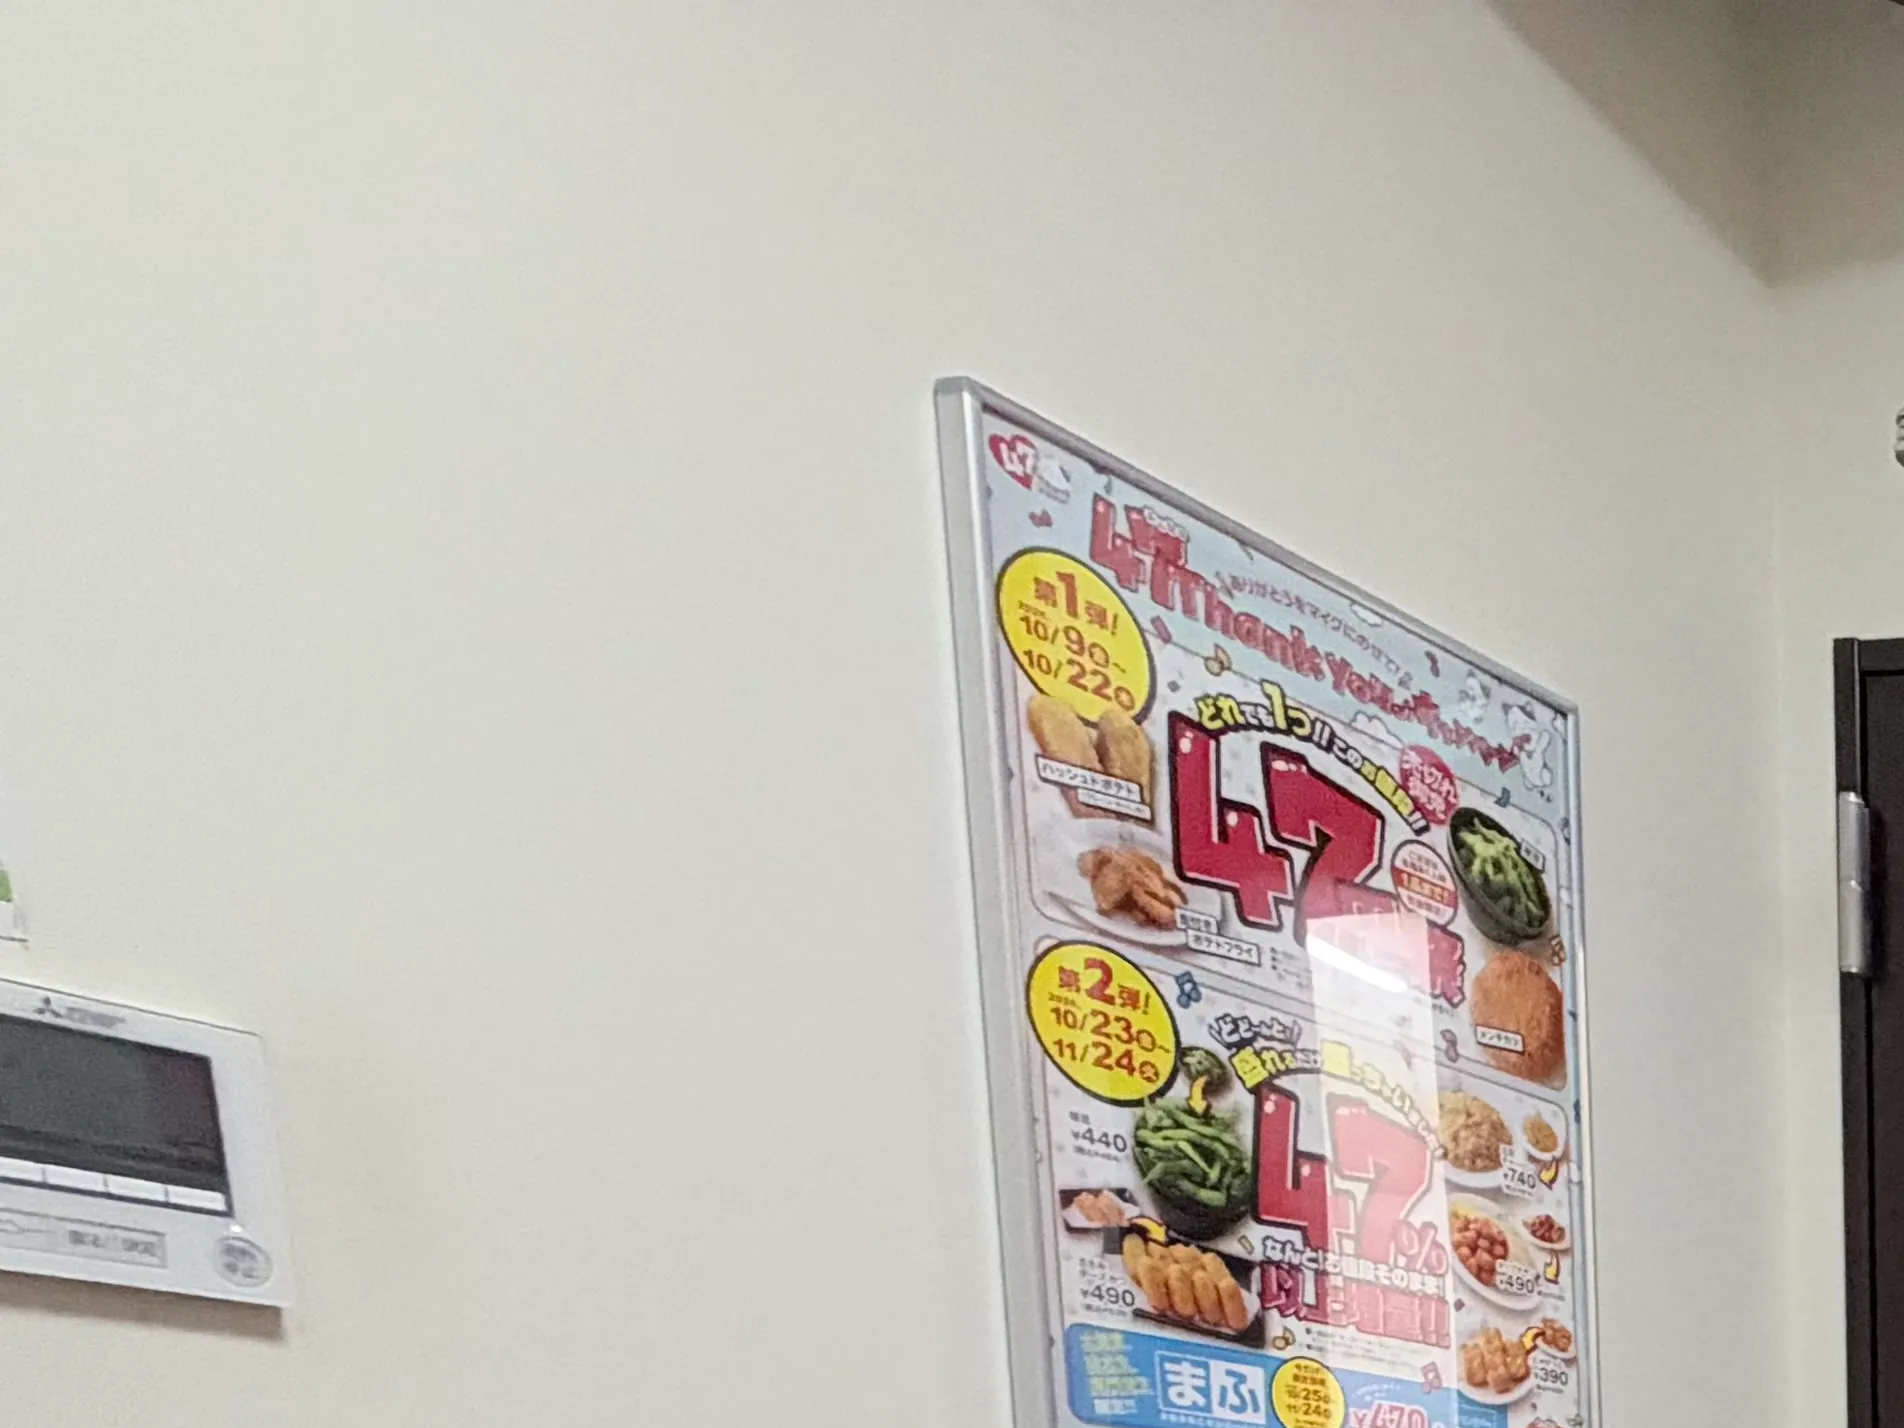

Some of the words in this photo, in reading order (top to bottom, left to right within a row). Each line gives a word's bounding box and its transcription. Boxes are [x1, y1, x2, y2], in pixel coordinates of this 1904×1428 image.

[1000, 440, 1036, 476] 47
[1057, 956, 1151, 1016] 第2弾!
[1071, 1128, 1128, 1153] ¥440
[1503, 1168, 1536, 1190] ¥740
[1080, 1285, 1136, 1308] ¥490
[1162, 1361, 1262, 1414] まふ
[1533, 1367, 1569, 1387] ¥390
